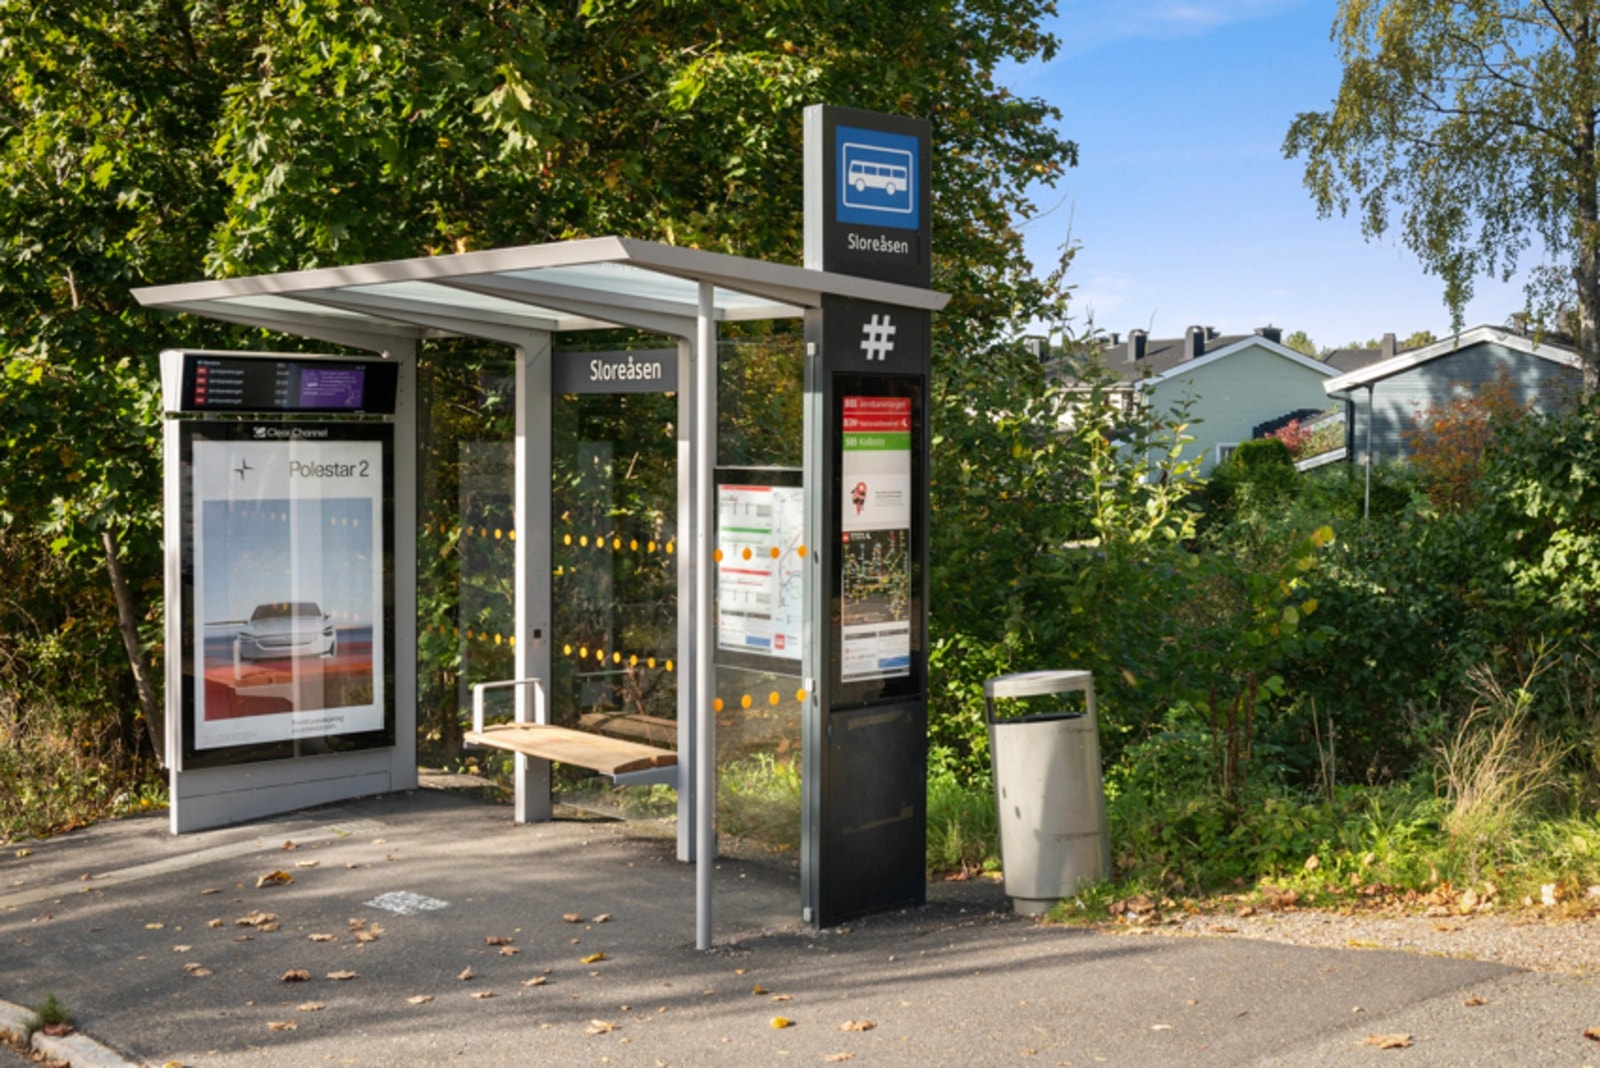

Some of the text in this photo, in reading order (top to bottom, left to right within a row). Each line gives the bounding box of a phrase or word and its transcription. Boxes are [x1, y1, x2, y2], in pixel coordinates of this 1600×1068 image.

[847, 232, 909, 254] Sloreåsen
[590, 355, 662, 382] Sloreåsen
[267, 427, 328, 438] Clear Channel
[289, 459, 370, 478] Polestar 2
